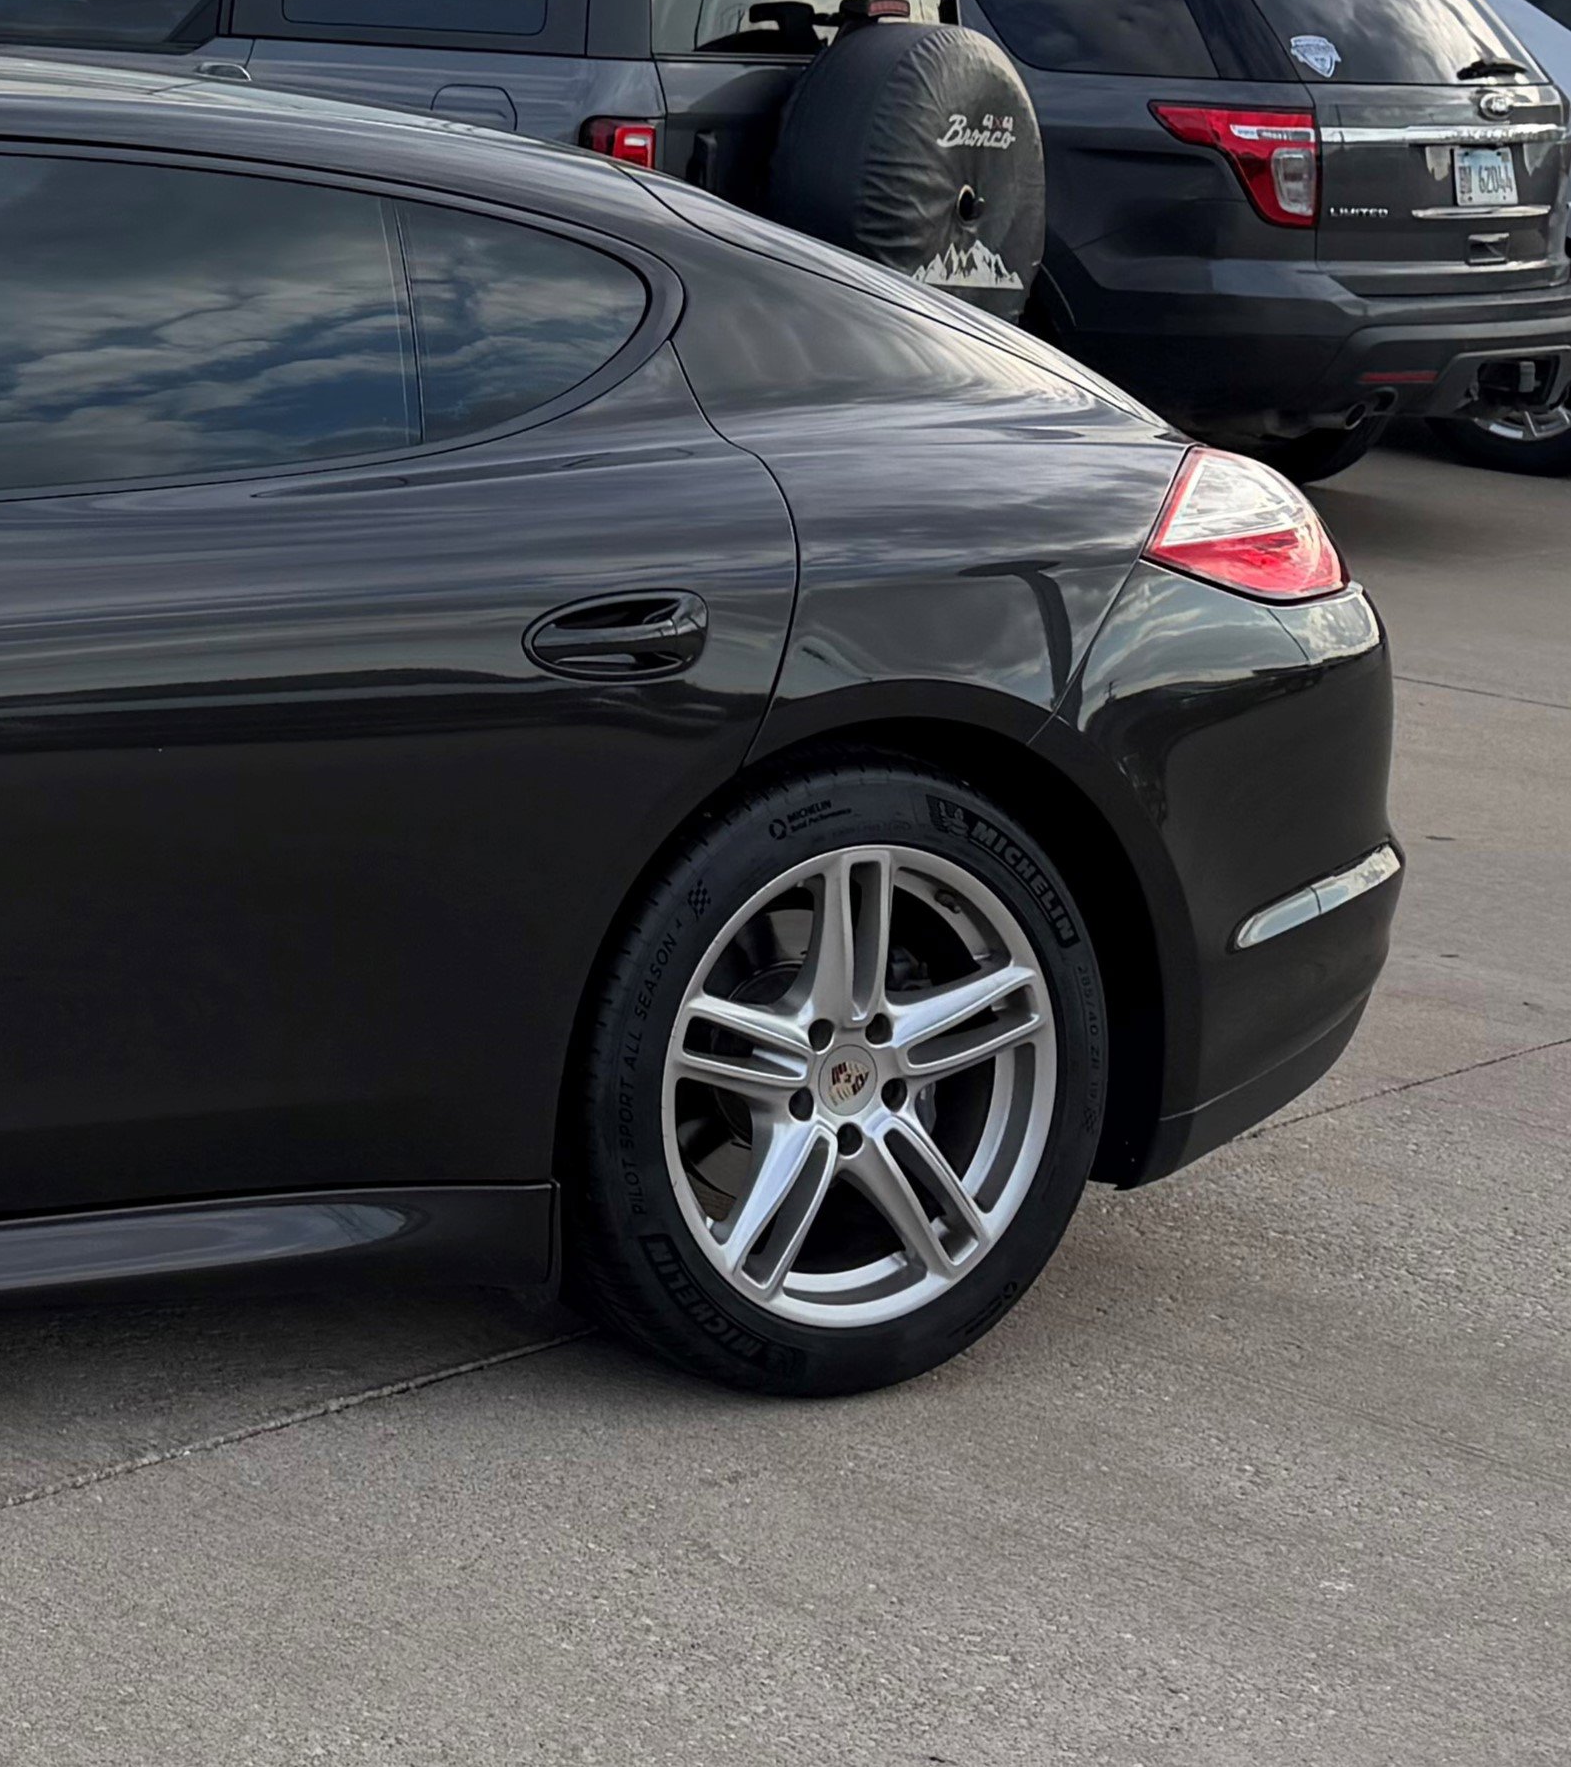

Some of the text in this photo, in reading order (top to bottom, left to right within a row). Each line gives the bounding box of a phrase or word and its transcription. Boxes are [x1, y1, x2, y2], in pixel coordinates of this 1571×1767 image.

[936, 113, 1016, 150] Bronco
[970, 819, 1075, 941] MICHELIN
[633, 933, 678, 1022] SEASON
[622, 1028, 643, 1076] ALL
[617, 1082, 637, 1151] SPORT
[621, 1161, 647, 1217] PILOT
[644, 1237, 764, 1359] MICHELIN
